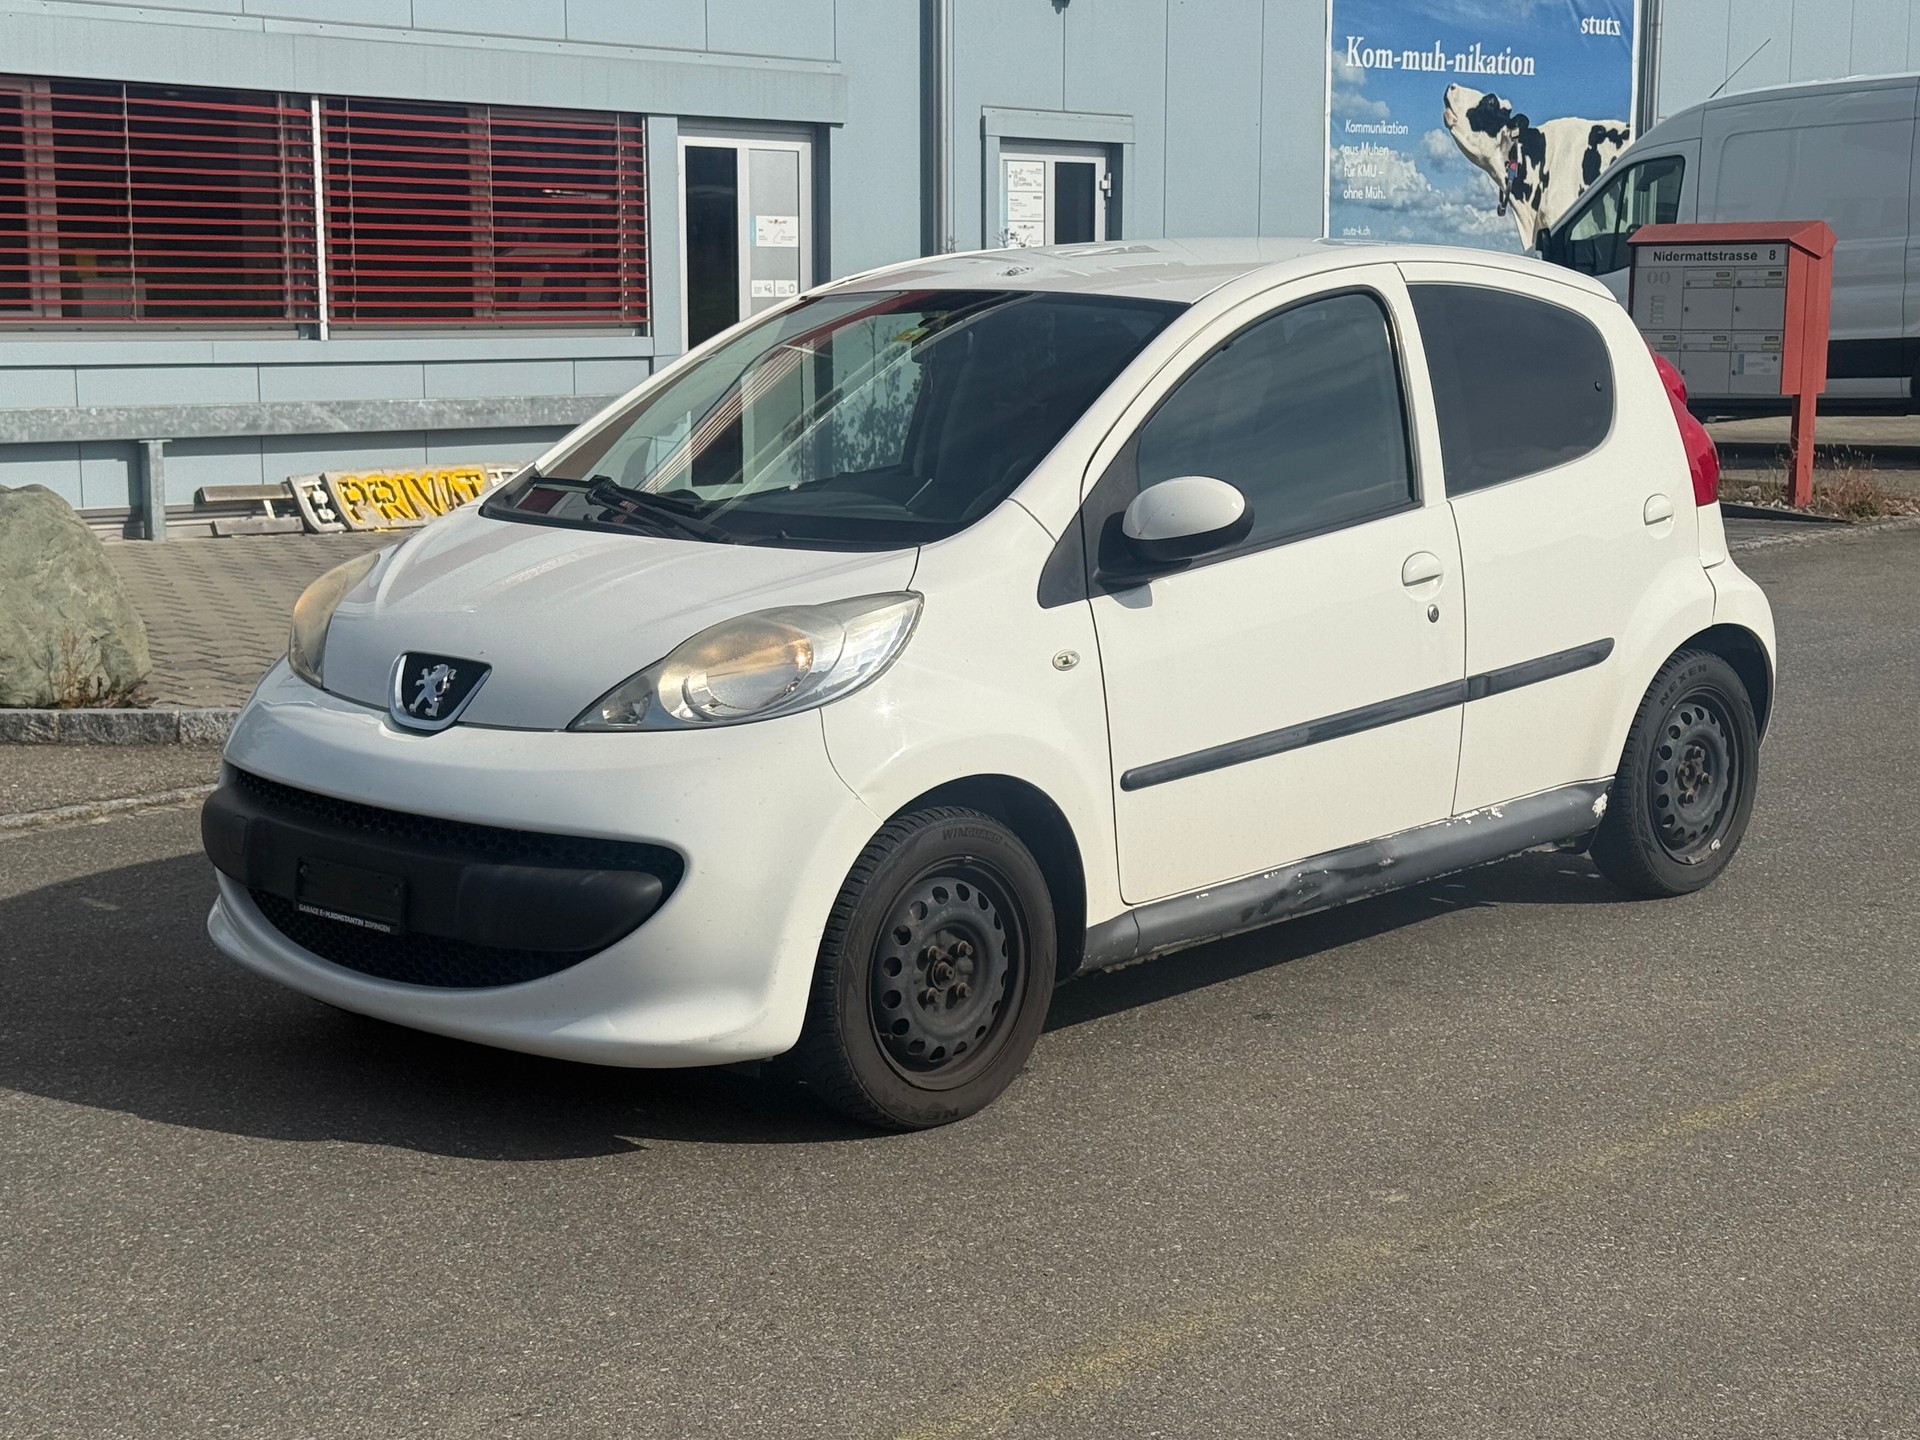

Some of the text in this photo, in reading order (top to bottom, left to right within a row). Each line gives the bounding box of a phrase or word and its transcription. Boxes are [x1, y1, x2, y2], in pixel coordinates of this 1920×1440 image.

[1345, 36, 1535, 76] Kom-muh-nikation
[1345, 119, 1409, 135] Kommunikation
[1344, 145, 1359, 156] aus
[1344, 164, 1355, 178] für
[1357, 164, 1377, 178] KMU
[1343, 185, 1386, 199] ohne Müh.
[1653, 249, 1777, 262] Nidermattstrasse 8
[1660, 664, 1708, 706] NEXEN
